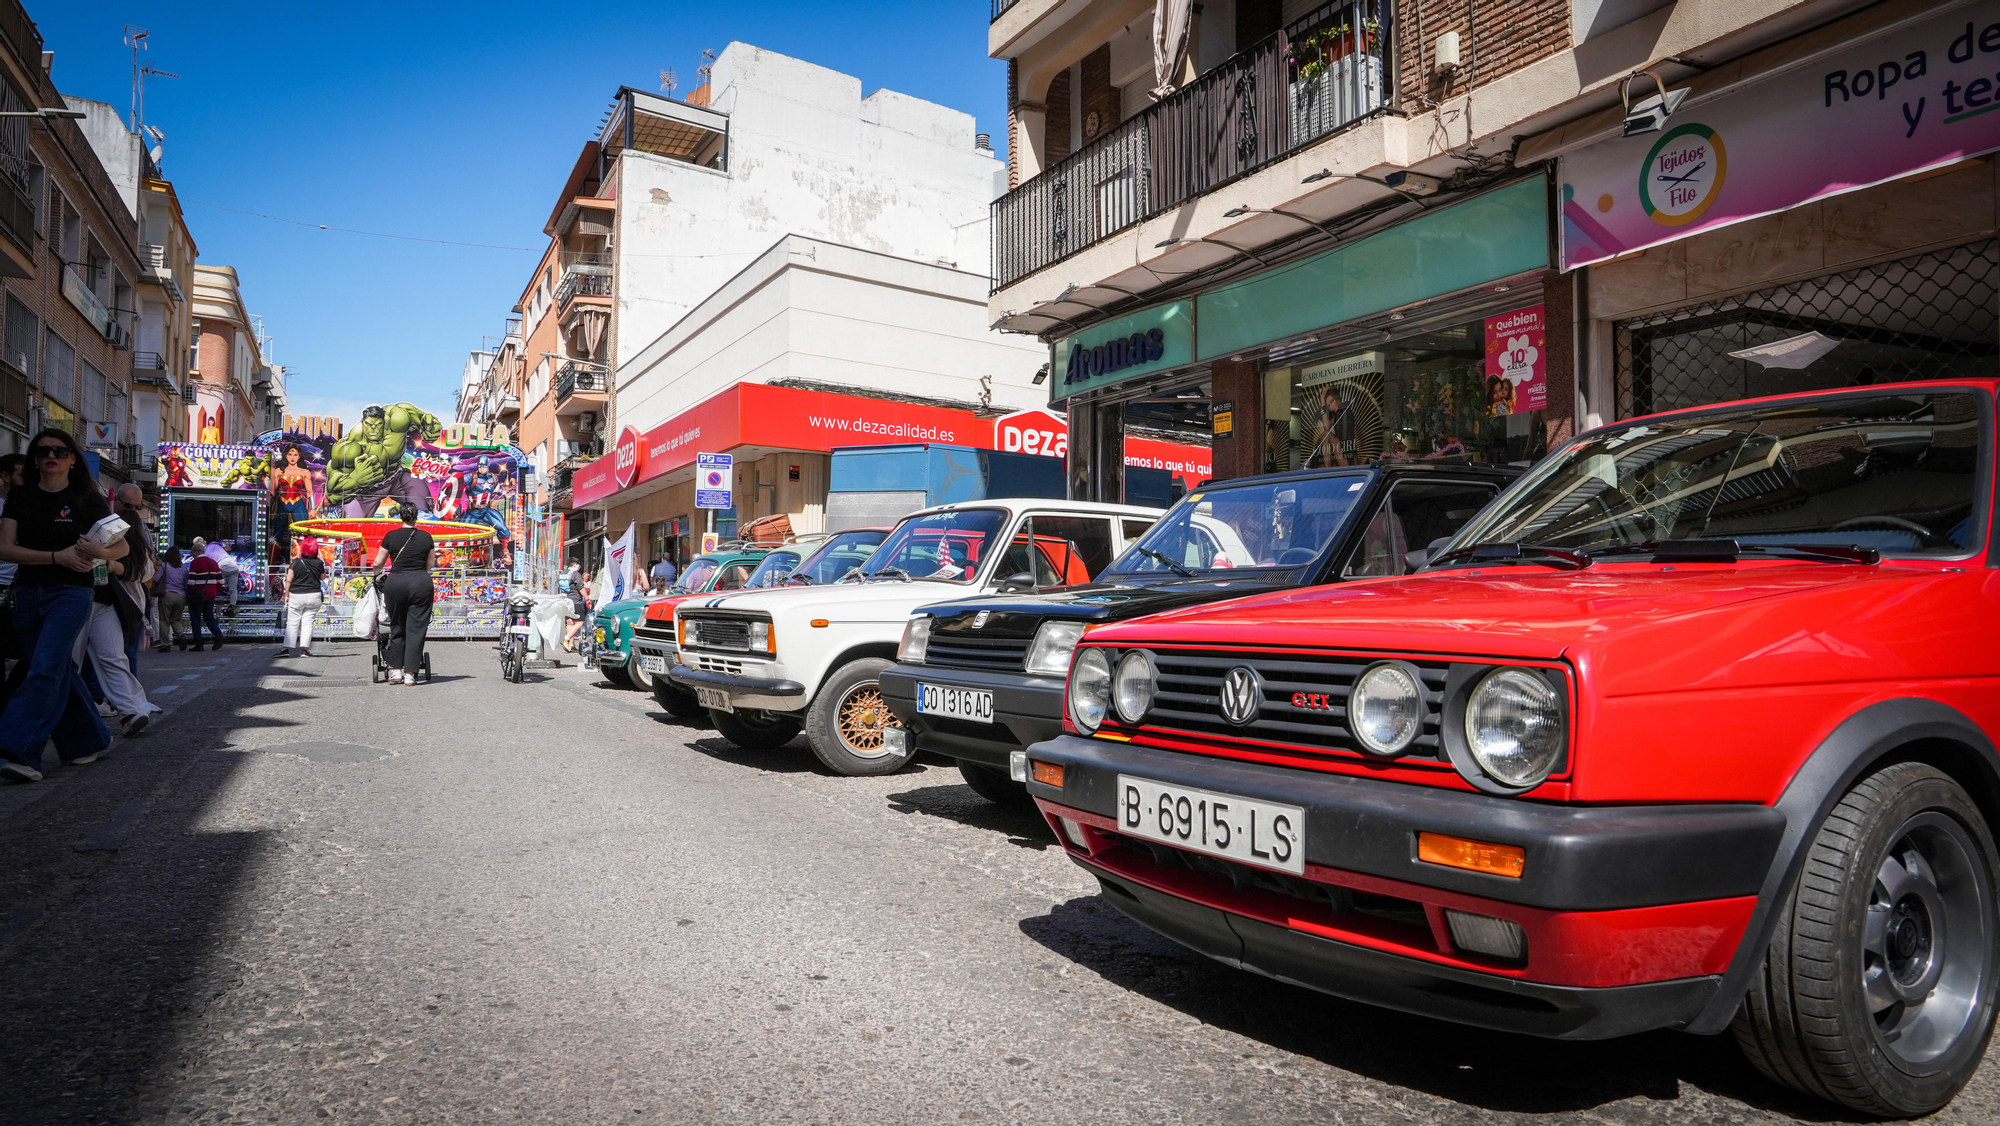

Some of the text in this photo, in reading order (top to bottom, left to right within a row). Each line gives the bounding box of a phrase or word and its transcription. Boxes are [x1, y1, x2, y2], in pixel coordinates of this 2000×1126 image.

[1825, 22, 2000, 107] Ropa de
[1903, 72, 2000, 138] y te
[1657, 146, 1706, 173] Tejidos
[1670, 188, 1697, 207] Filo
[1496, 312, 1537, 330] Qué bien
[1496, 329, 1516, 339] hueles
[1064, 328, 1164, 385] Aromas
[1303, 360, 1373, 382] CAROLINA HERRERA
[283, 414, 510, 449] MINI OLLA
[809, 415, 954, 442] www.dezacalidad.es
[185, 447, 245, 460] CONTROL
[700, 455, 707, 463] P
[191, 461, 213, 469] MINI
[411, 456, 451, 477] BOOM
[1153, 456, 1163, 469] lo
[1165, 460, 1183, 474] que
[1185, 460, 1195, 473] tú
[923, 686, 938, 710] CO
[942, 688, 972, 716] 1316
[975, 692, 992, 718] AD
[1292, 692, 1329, 709] GTI
